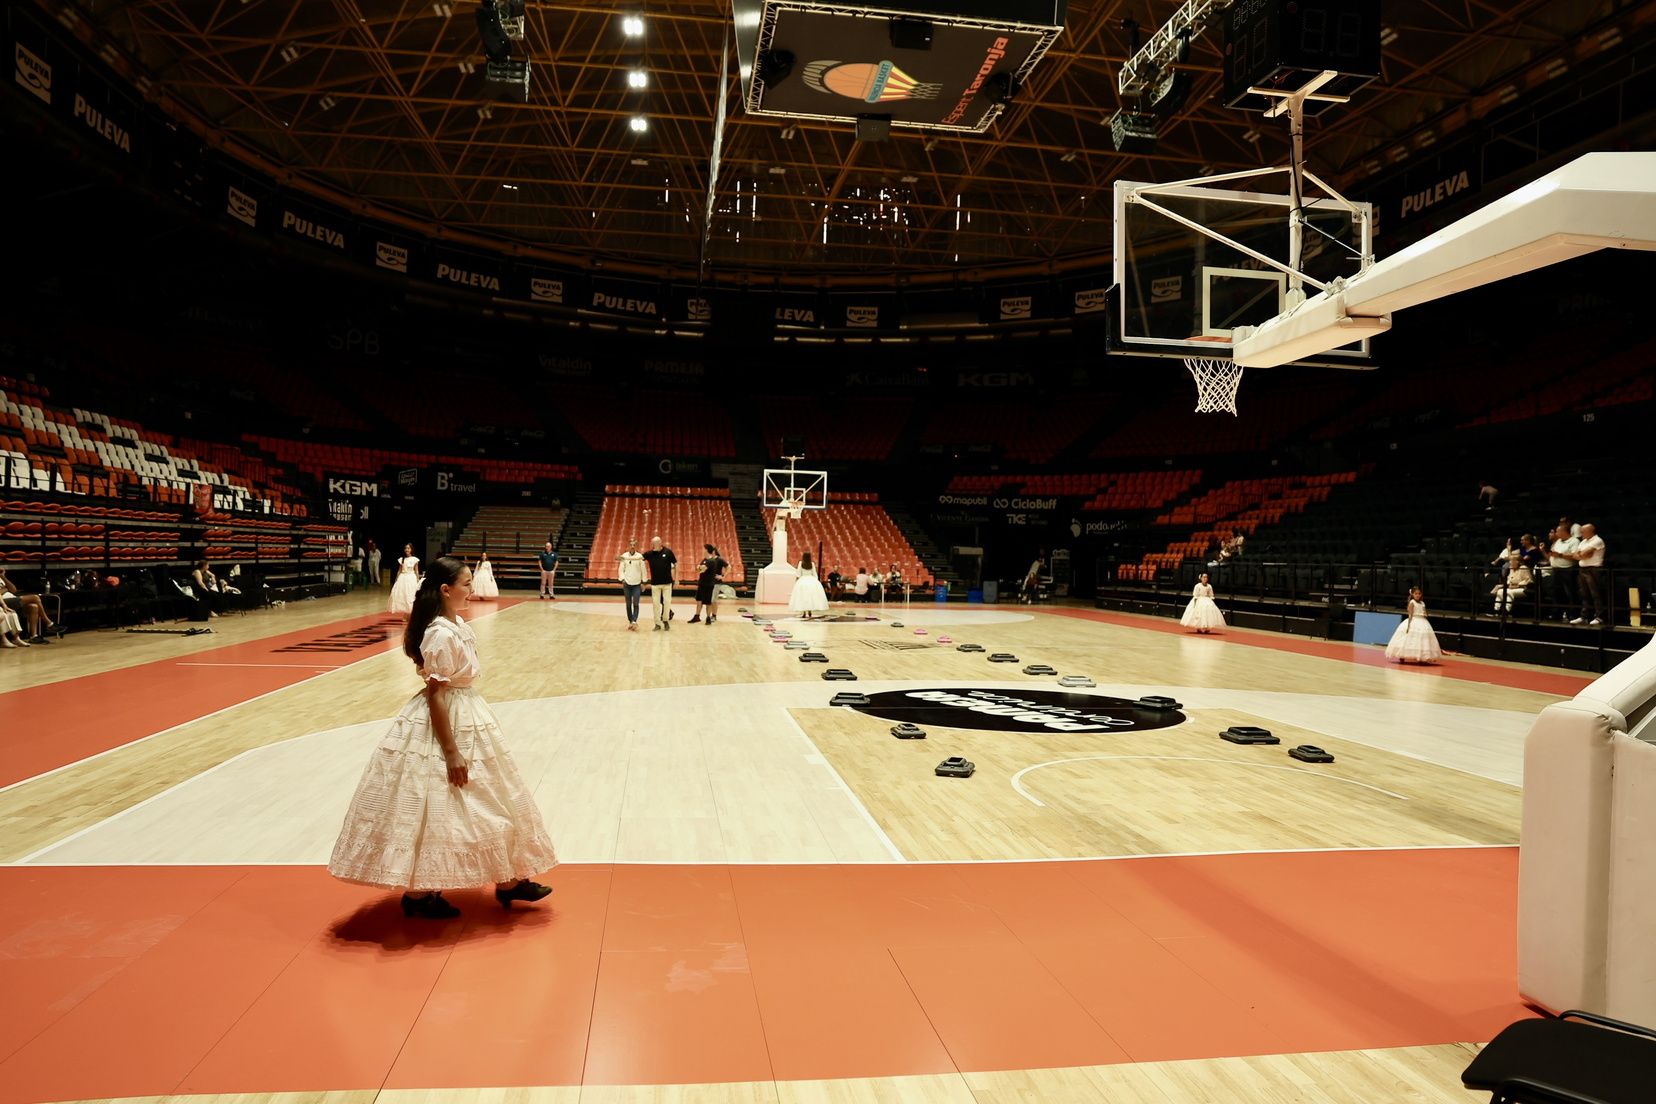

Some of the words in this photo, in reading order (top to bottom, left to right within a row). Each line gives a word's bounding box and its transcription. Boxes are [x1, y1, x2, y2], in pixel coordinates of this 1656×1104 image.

[18, 48, 50, 80] PULEVA
[962, 37, 1009, 96] Taronja
[74, 92, 132, 154] PULEVA
[1400, 170, 1471, 219] PULEVA
[282, 209, 345, 249] PULEVA
[378, 245, 407, 259] PULEVA
[436, 263, 500, 292] PULEVA
[533, 280, 561, 291] PULEVA
[1153, 279, 1181, 290] PULEVA
[593, 291, 658, 315] PULEVA
[1076, 290, 1105, 302] PULEVA
[848, 308, 877, 316] PULEVA
[1002, 300, 1030, 309] PULEVA
[773, 306, 815, 322] LEVA
[956, 371, 1035, 388] KGM
[328, 478, 379, 498] KGM
[450, 483, 476, 493] travel
[1011, 498, 1057, 510] CicloBuff
